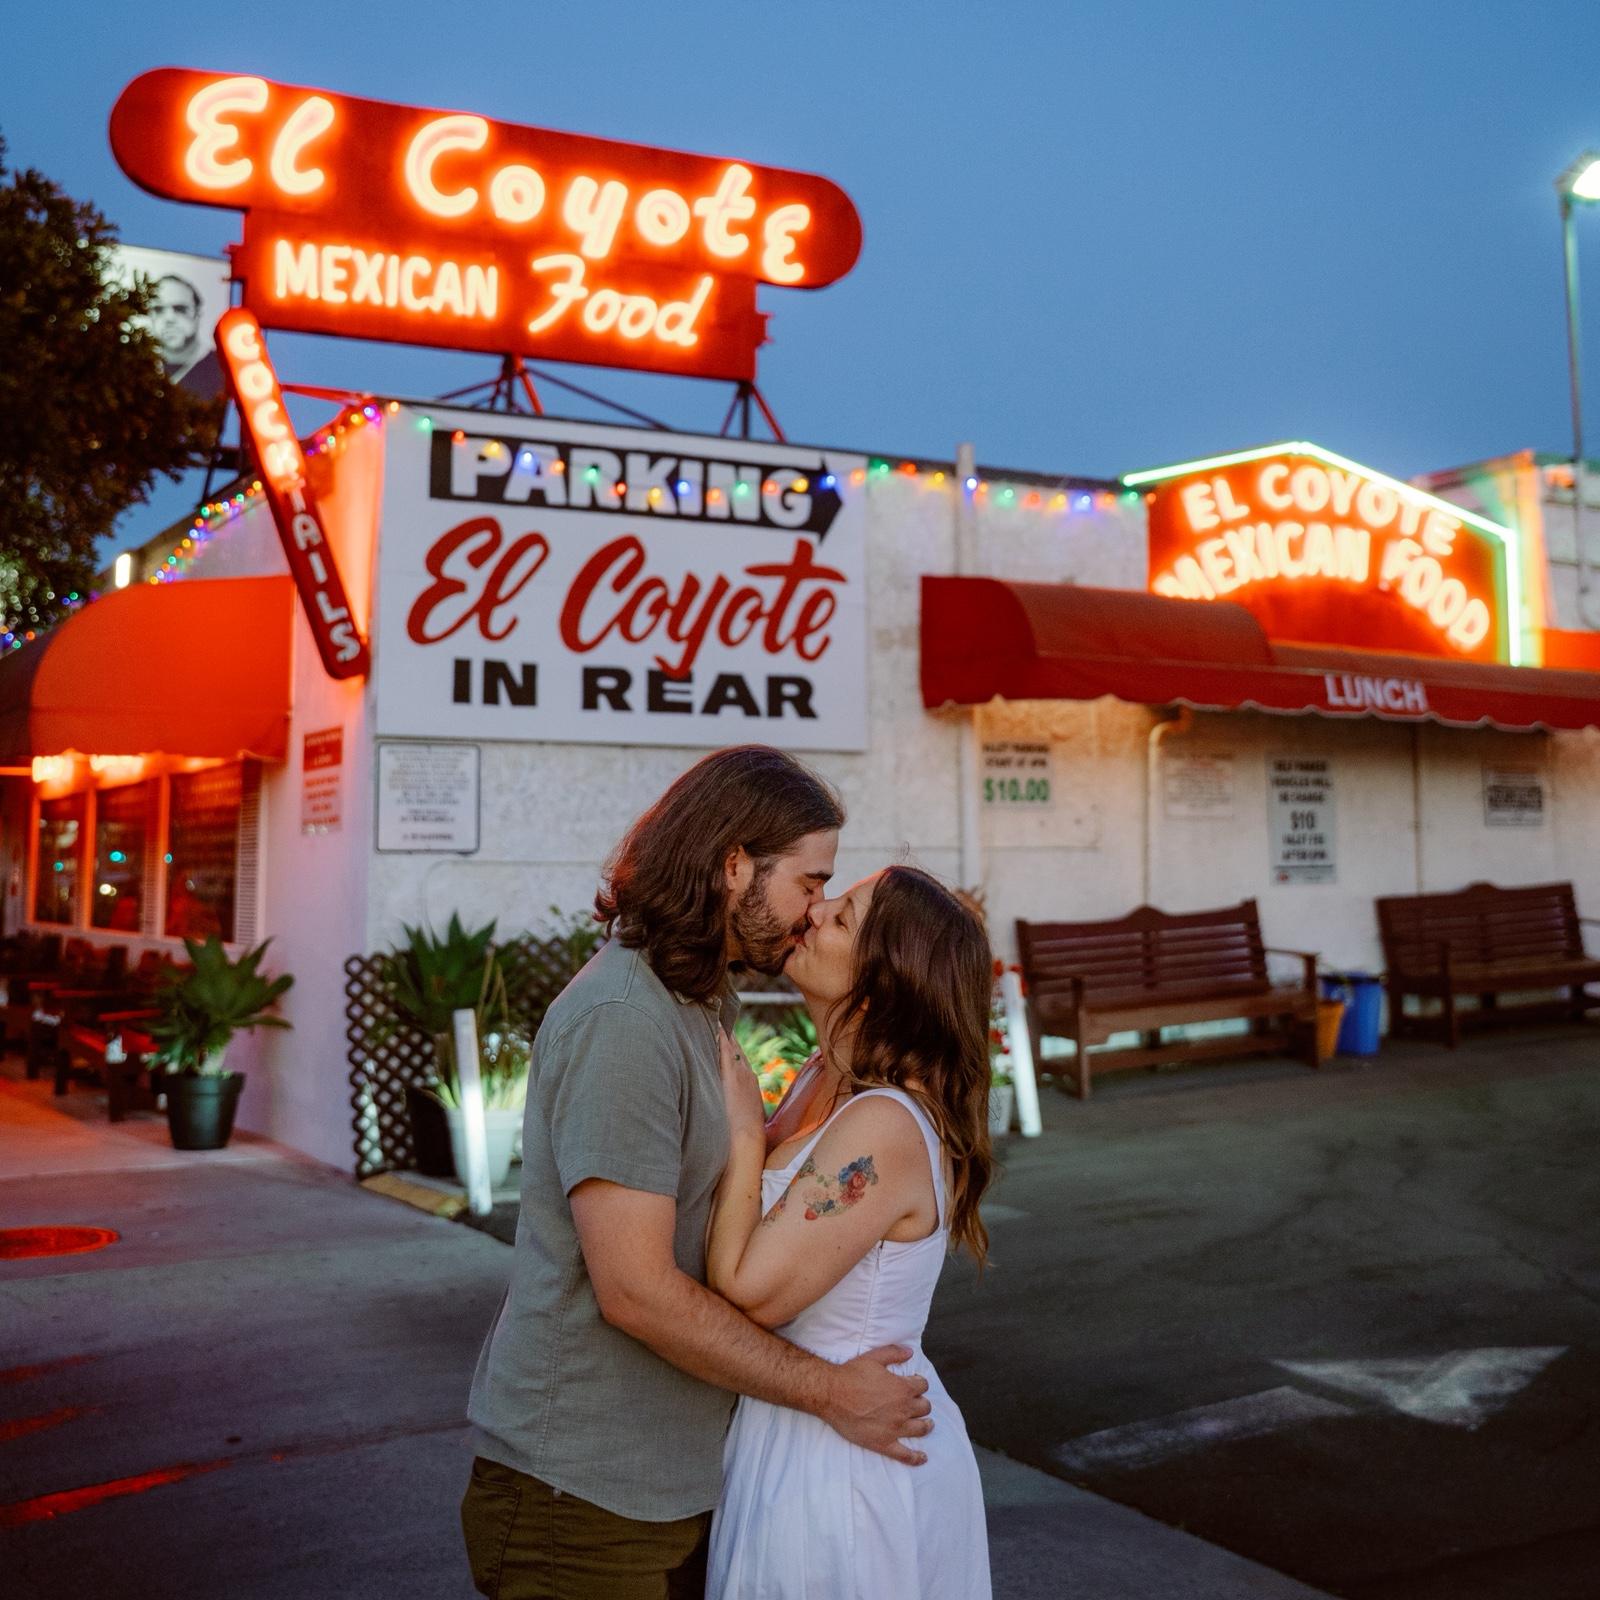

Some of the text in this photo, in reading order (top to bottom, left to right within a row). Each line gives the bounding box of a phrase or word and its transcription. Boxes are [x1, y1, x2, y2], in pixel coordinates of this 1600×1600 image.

[185, 76, 811, 283] El Coyote
[275, 240, 713, 347] MEXICAN Food
[450, 436, 812, 528] PARKING
[1183, 464, 1462, 556] EL COYOTE
[407, 517, 847, 679] El Coyote
[1153, 522, 1490, 651] MEXICAN FOOD
[453, 659, 818, 719] IN REAR
[1324, 673, 1426, 711] LUNCH
[983, 777, 1050, 802] $10.00
[1290, 810, 1316, 831] $10
